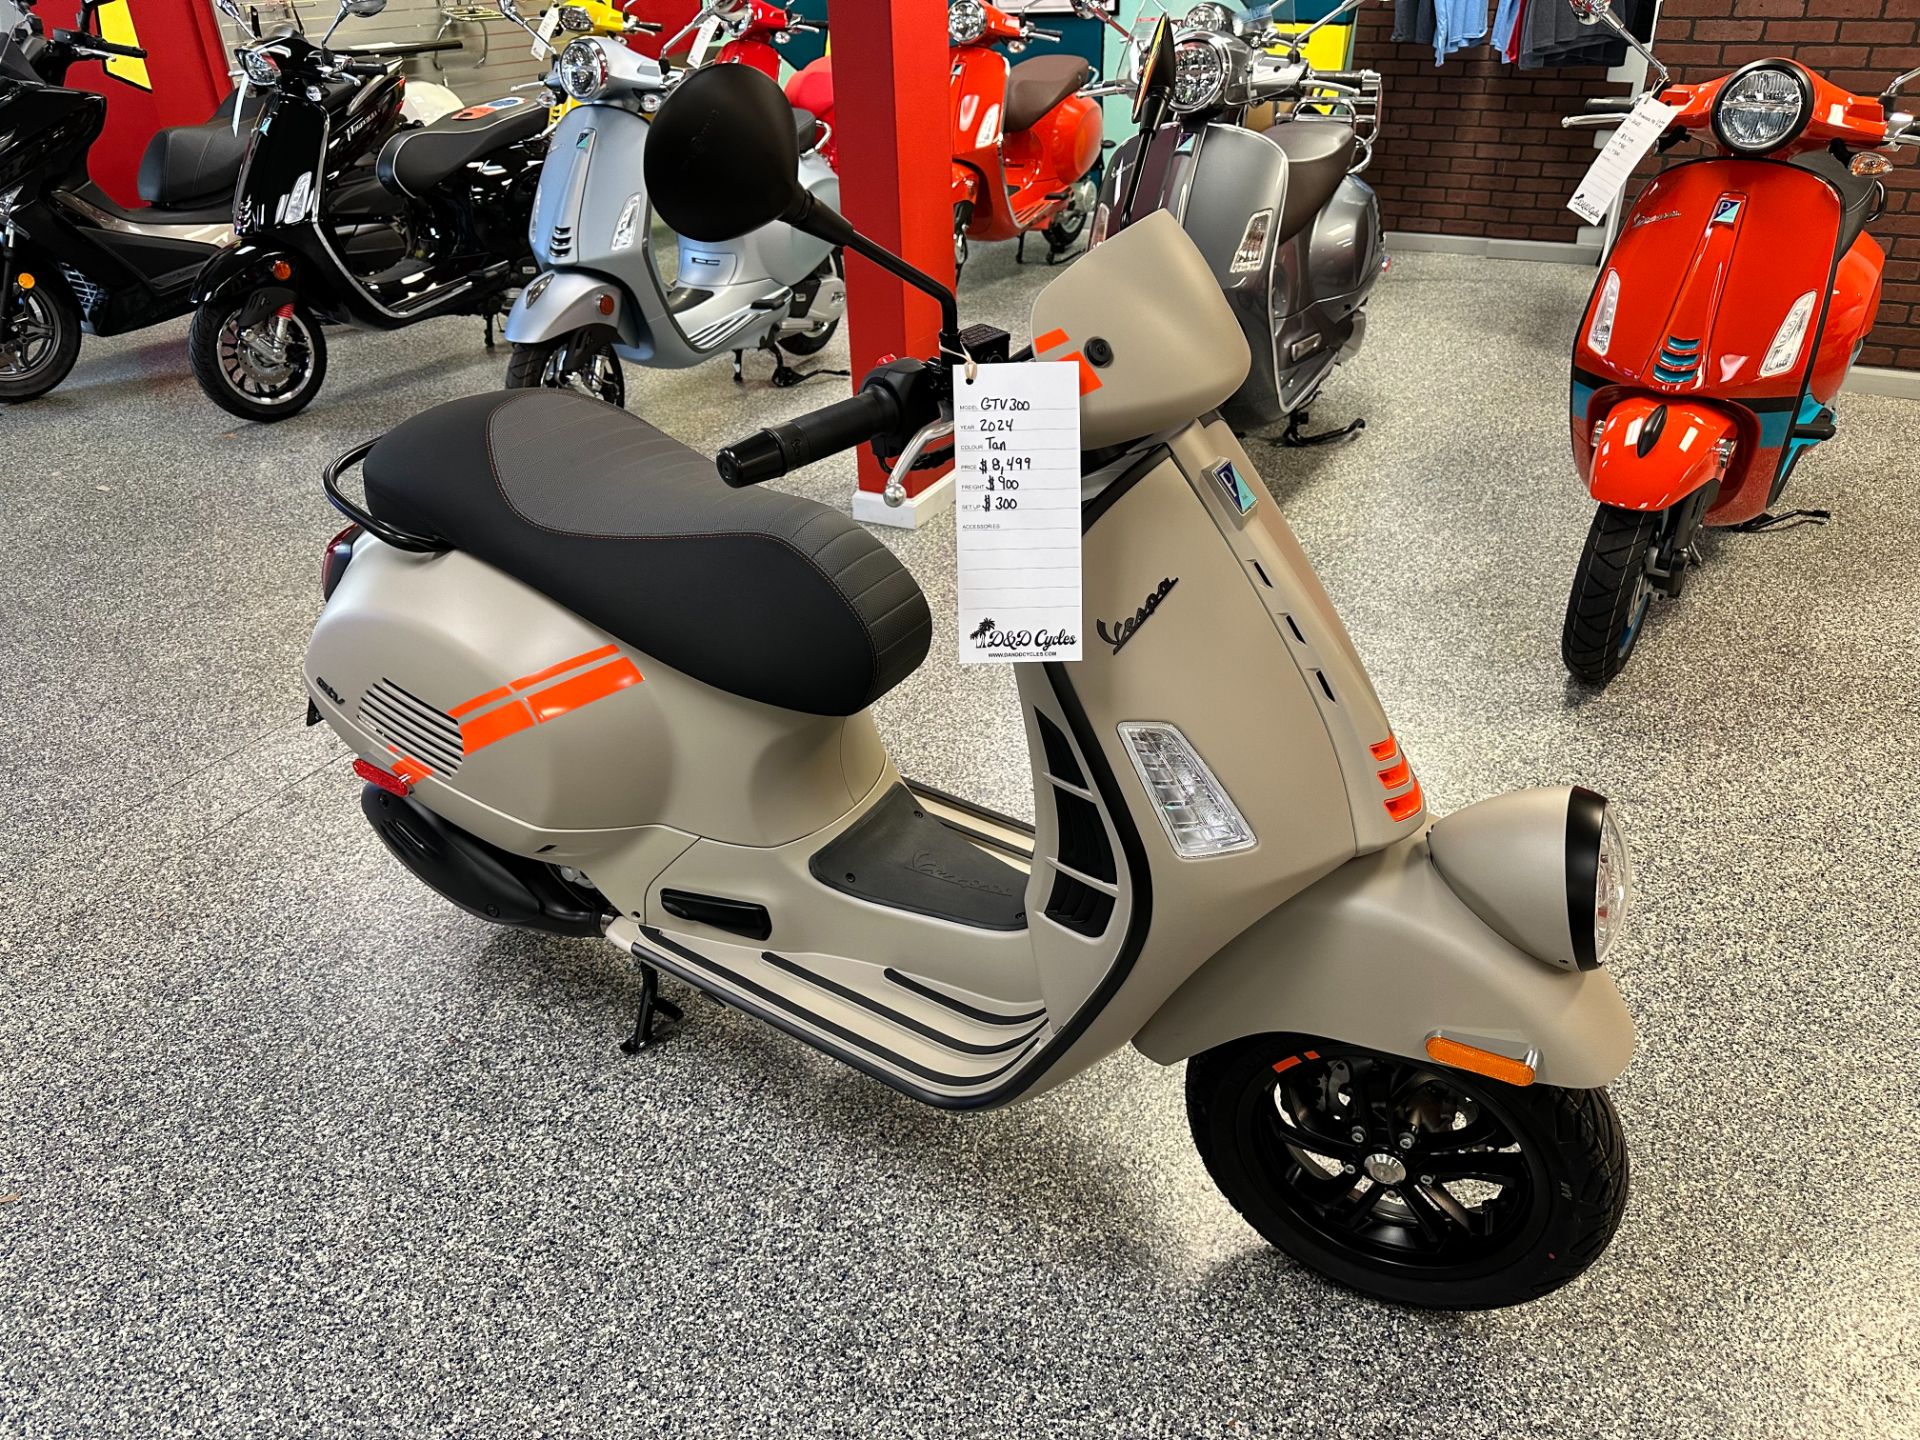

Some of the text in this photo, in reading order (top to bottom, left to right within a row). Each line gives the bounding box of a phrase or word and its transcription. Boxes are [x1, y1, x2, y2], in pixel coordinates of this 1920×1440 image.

[980, 418, 1014, 432] 2024
[985, 436, 1006, 451] Tan
[1096, 577, 1179, 656] Vespa
[987, 628, 1077, 651] D&D Cycles
